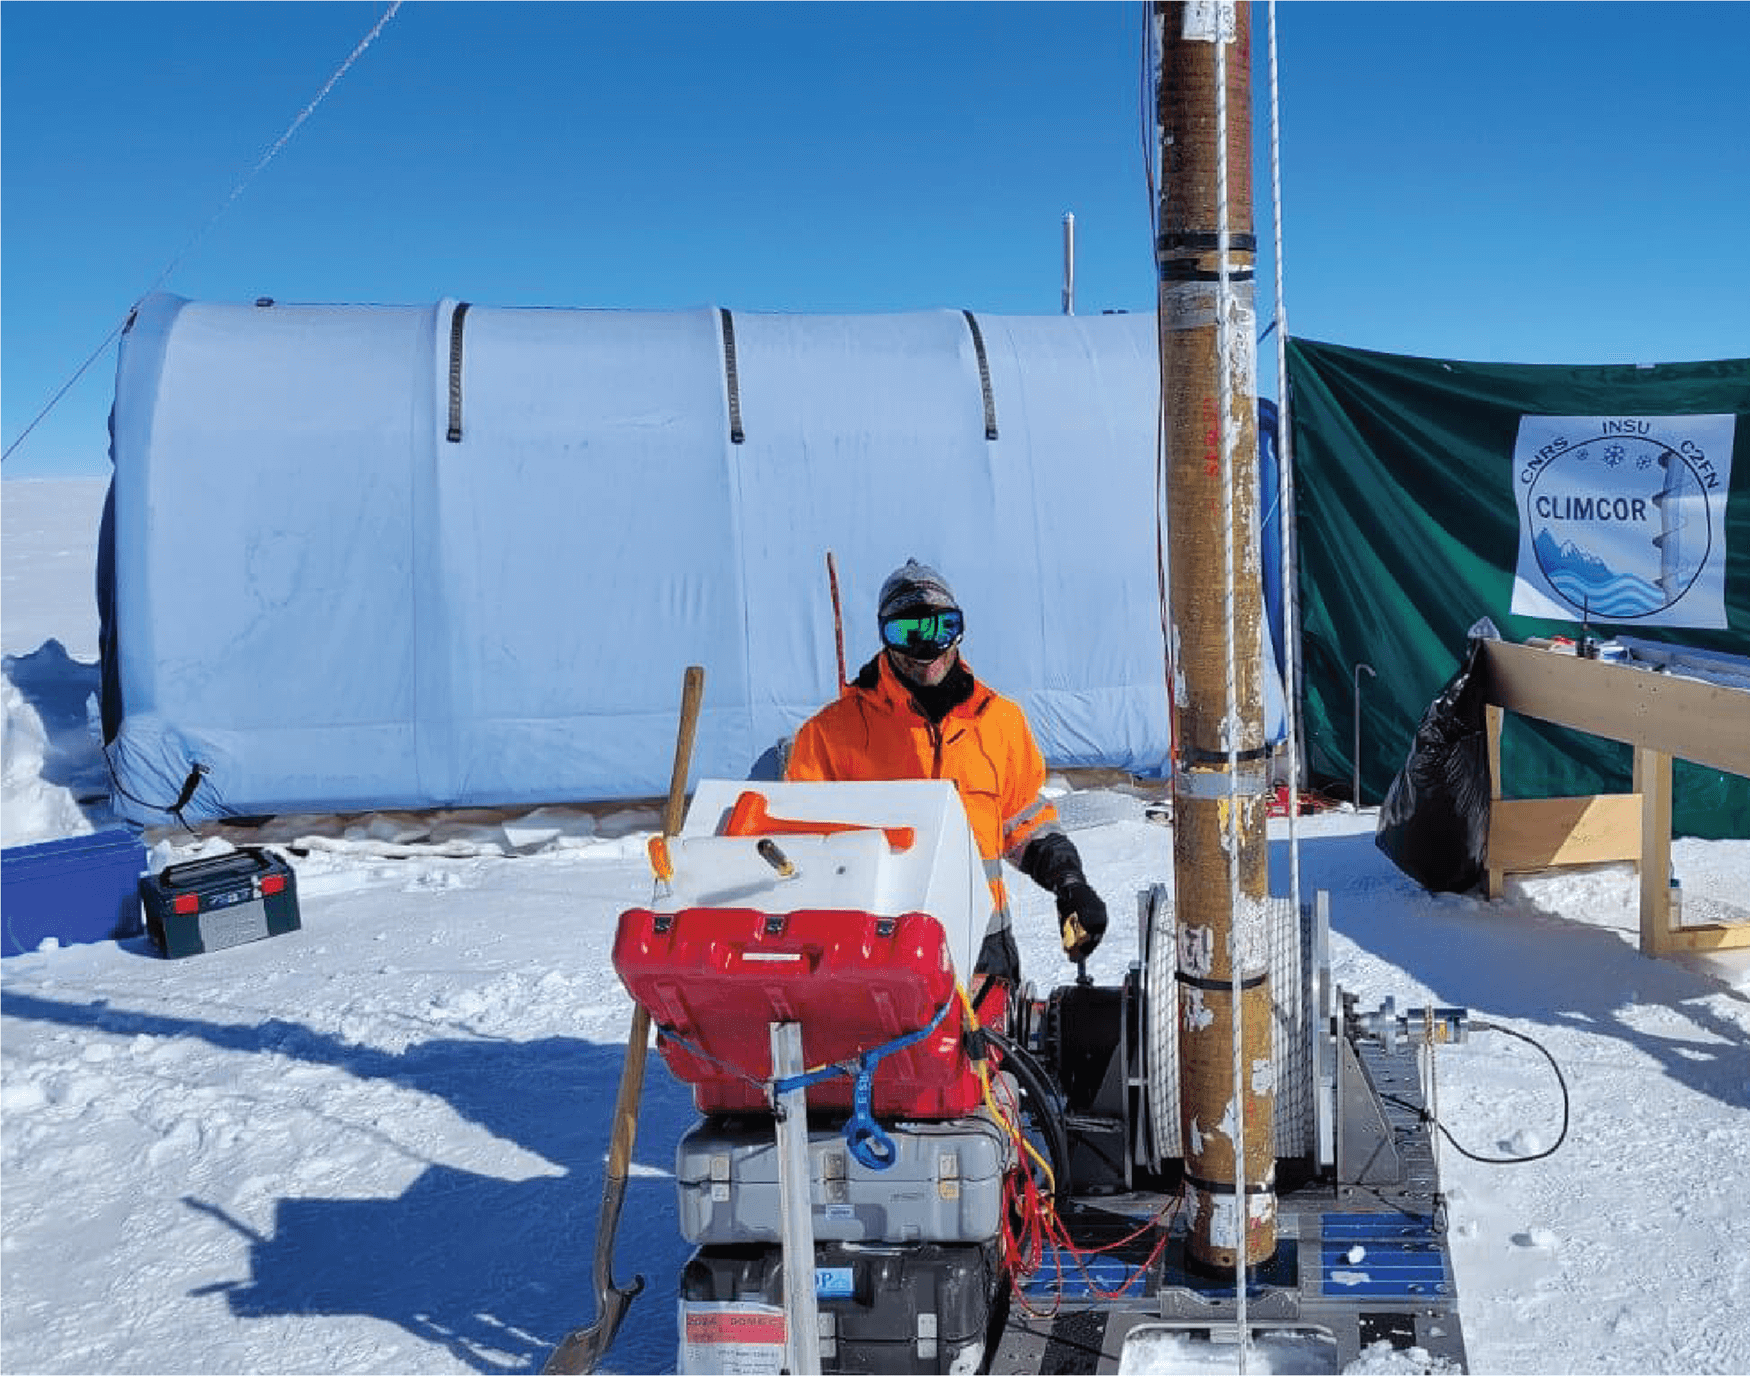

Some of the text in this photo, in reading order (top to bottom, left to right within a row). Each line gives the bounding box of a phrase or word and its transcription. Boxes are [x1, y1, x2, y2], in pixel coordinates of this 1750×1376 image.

[1521, 419, 1719, 489] CNRS INSU C2FN
[1536, 495, 1647, 521] CLIMCOR
